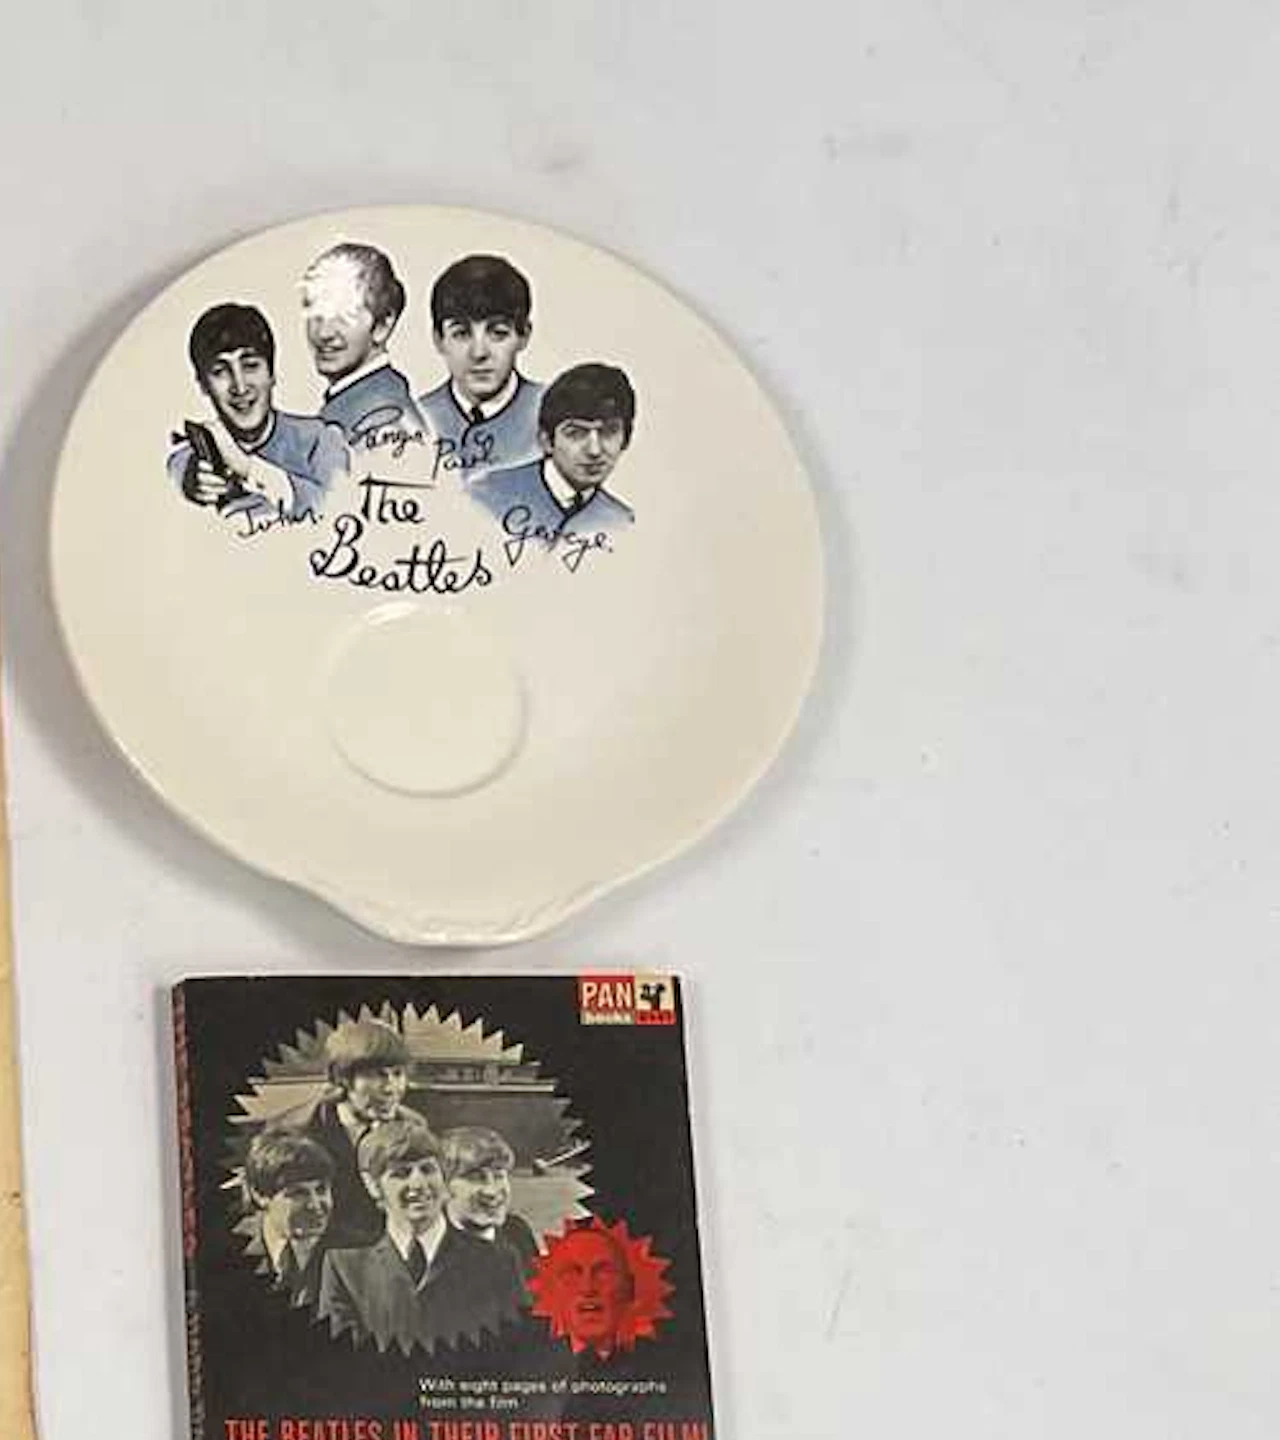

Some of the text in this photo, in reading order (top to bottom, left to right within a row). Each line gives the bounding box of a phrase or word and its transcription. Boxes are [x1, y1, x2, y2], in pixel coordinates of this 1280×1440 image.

[358, 477, 435, 526] The
[310, 515, 493, 594] Beatles
[582, 981, 633, 1008] PAN
